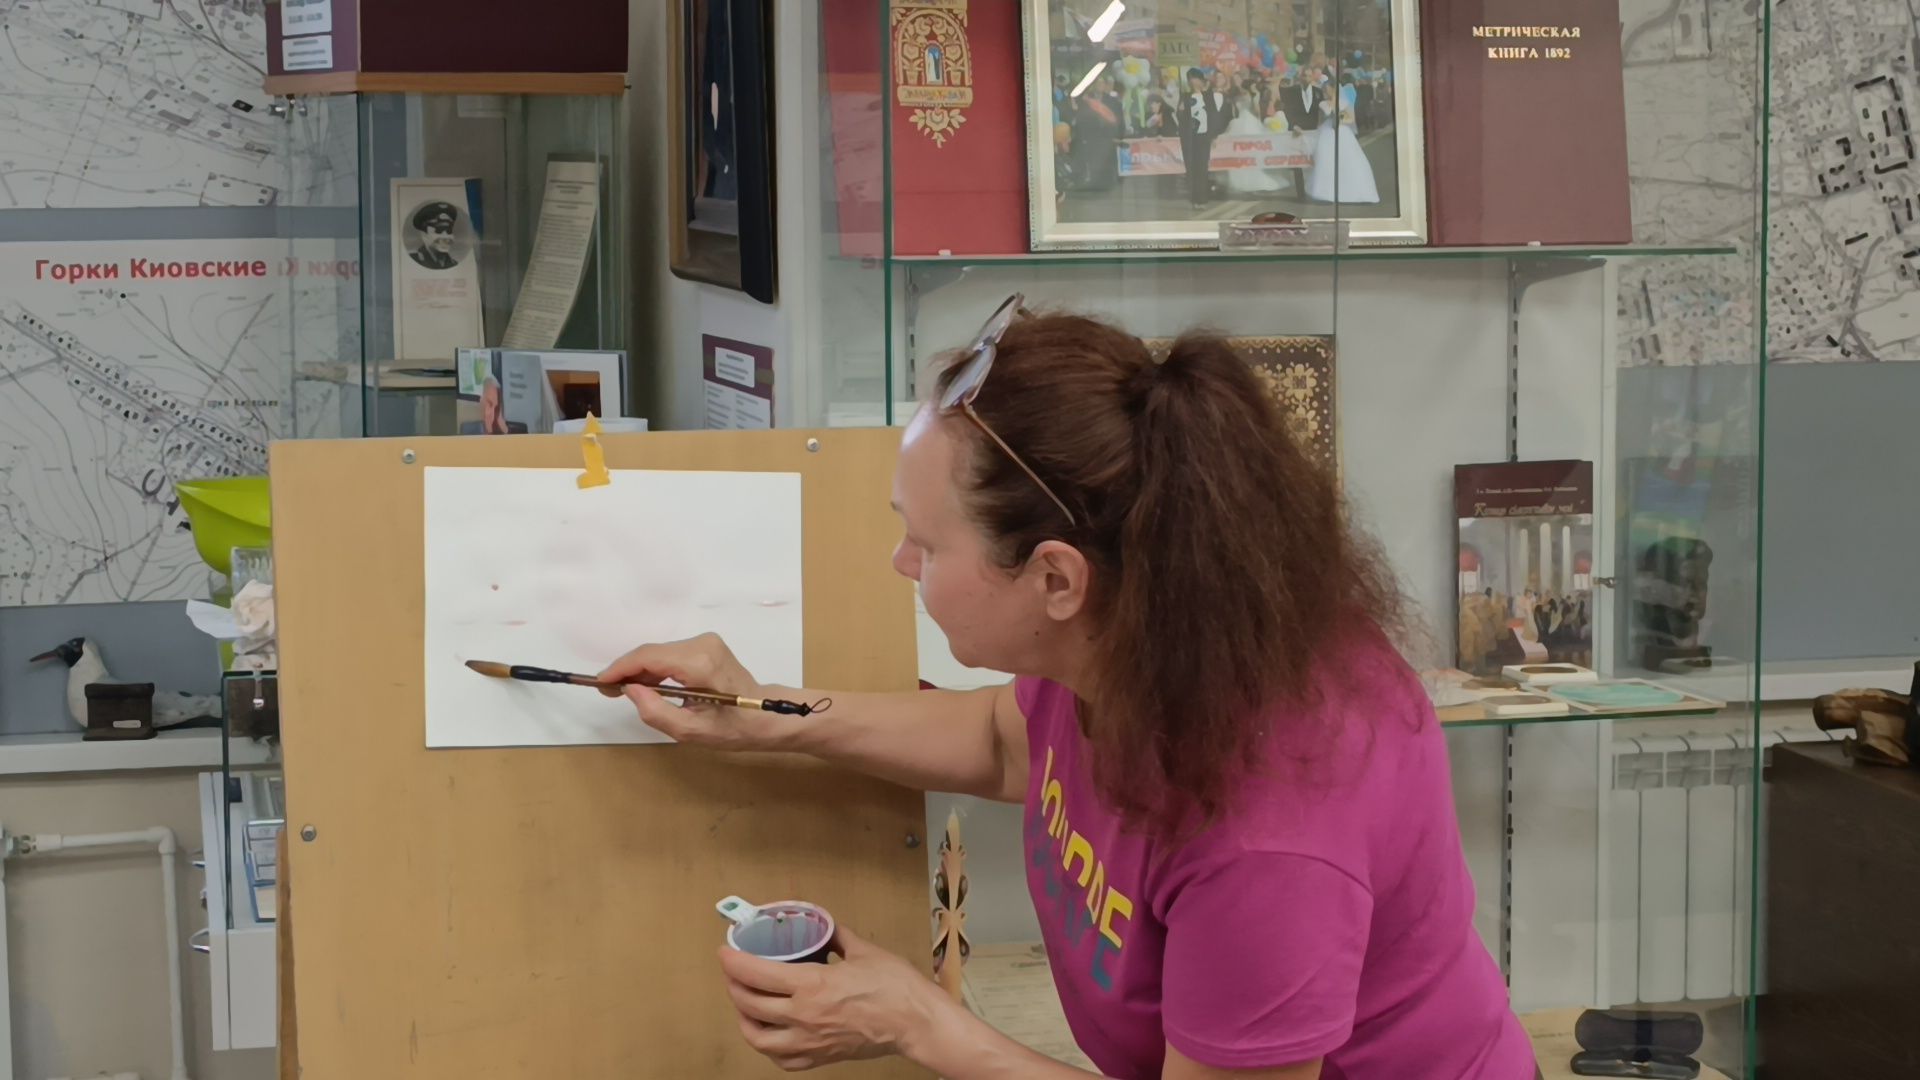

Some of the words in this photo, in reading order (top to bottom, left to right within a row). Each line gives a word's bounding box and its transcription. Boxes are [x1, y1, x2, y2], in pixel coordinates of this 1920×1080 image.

[1472, 26, 1581, 38] МЕТРИЧЕСКАЯ
[1487, 47, 1539, 59] КНИГА
[1545, 47, 1571, 59] 1892
[35, 259, 118, 284] Горки
[130, 257, 267, 278] Киовские
